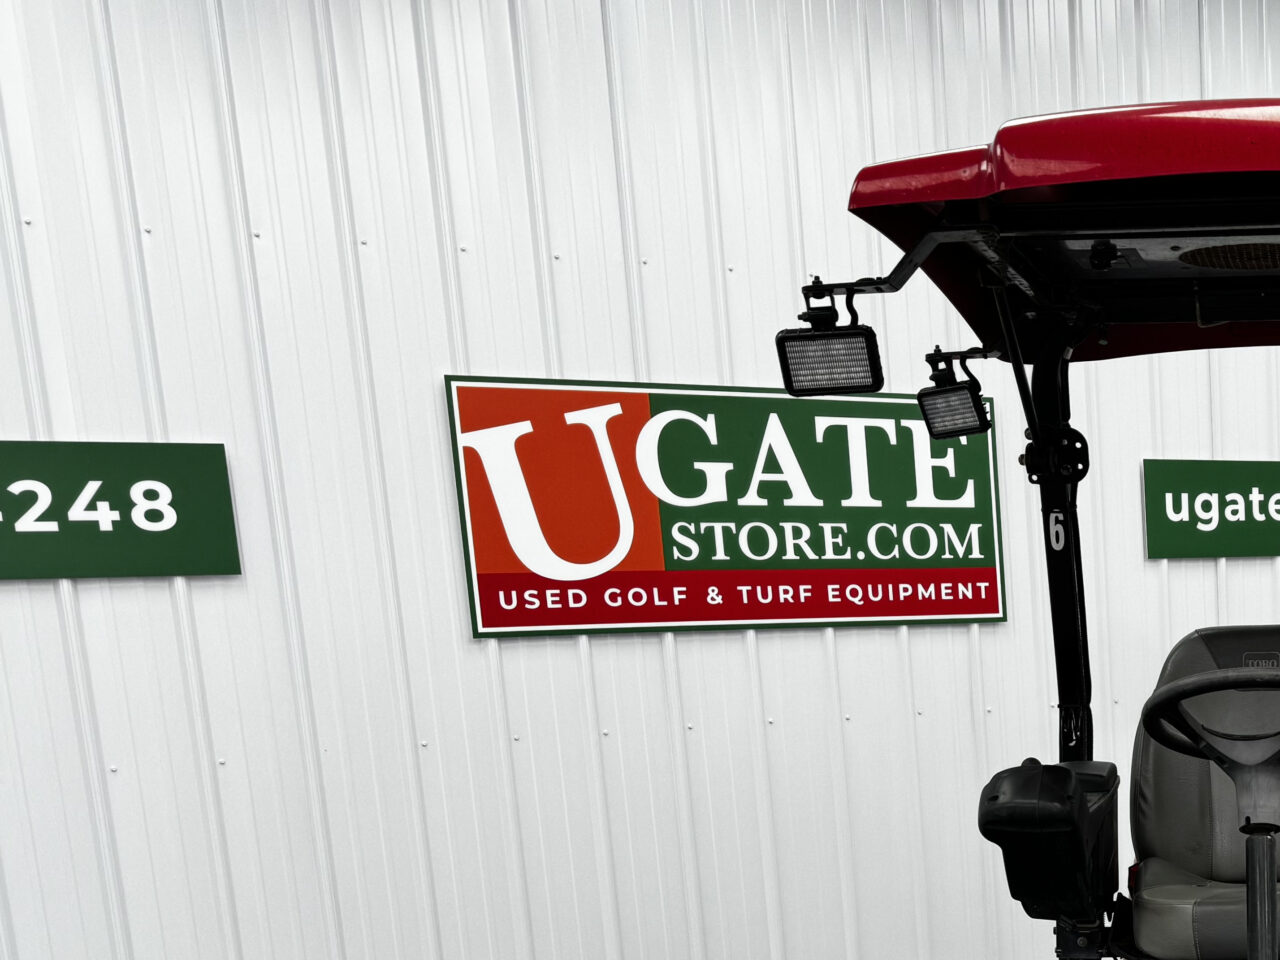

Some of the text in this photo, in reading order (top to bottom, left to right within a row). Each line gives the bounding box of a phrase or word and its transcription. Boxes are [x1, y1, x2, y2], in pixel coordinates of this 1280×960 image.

[0, 479, 178, 533] 248
[671, 521, 985, 561] STORE.COM
[1049, 512, 1065, 551] 6
[498, 582, 990, 610] USED GOLF & TURF EQUIPMENT
